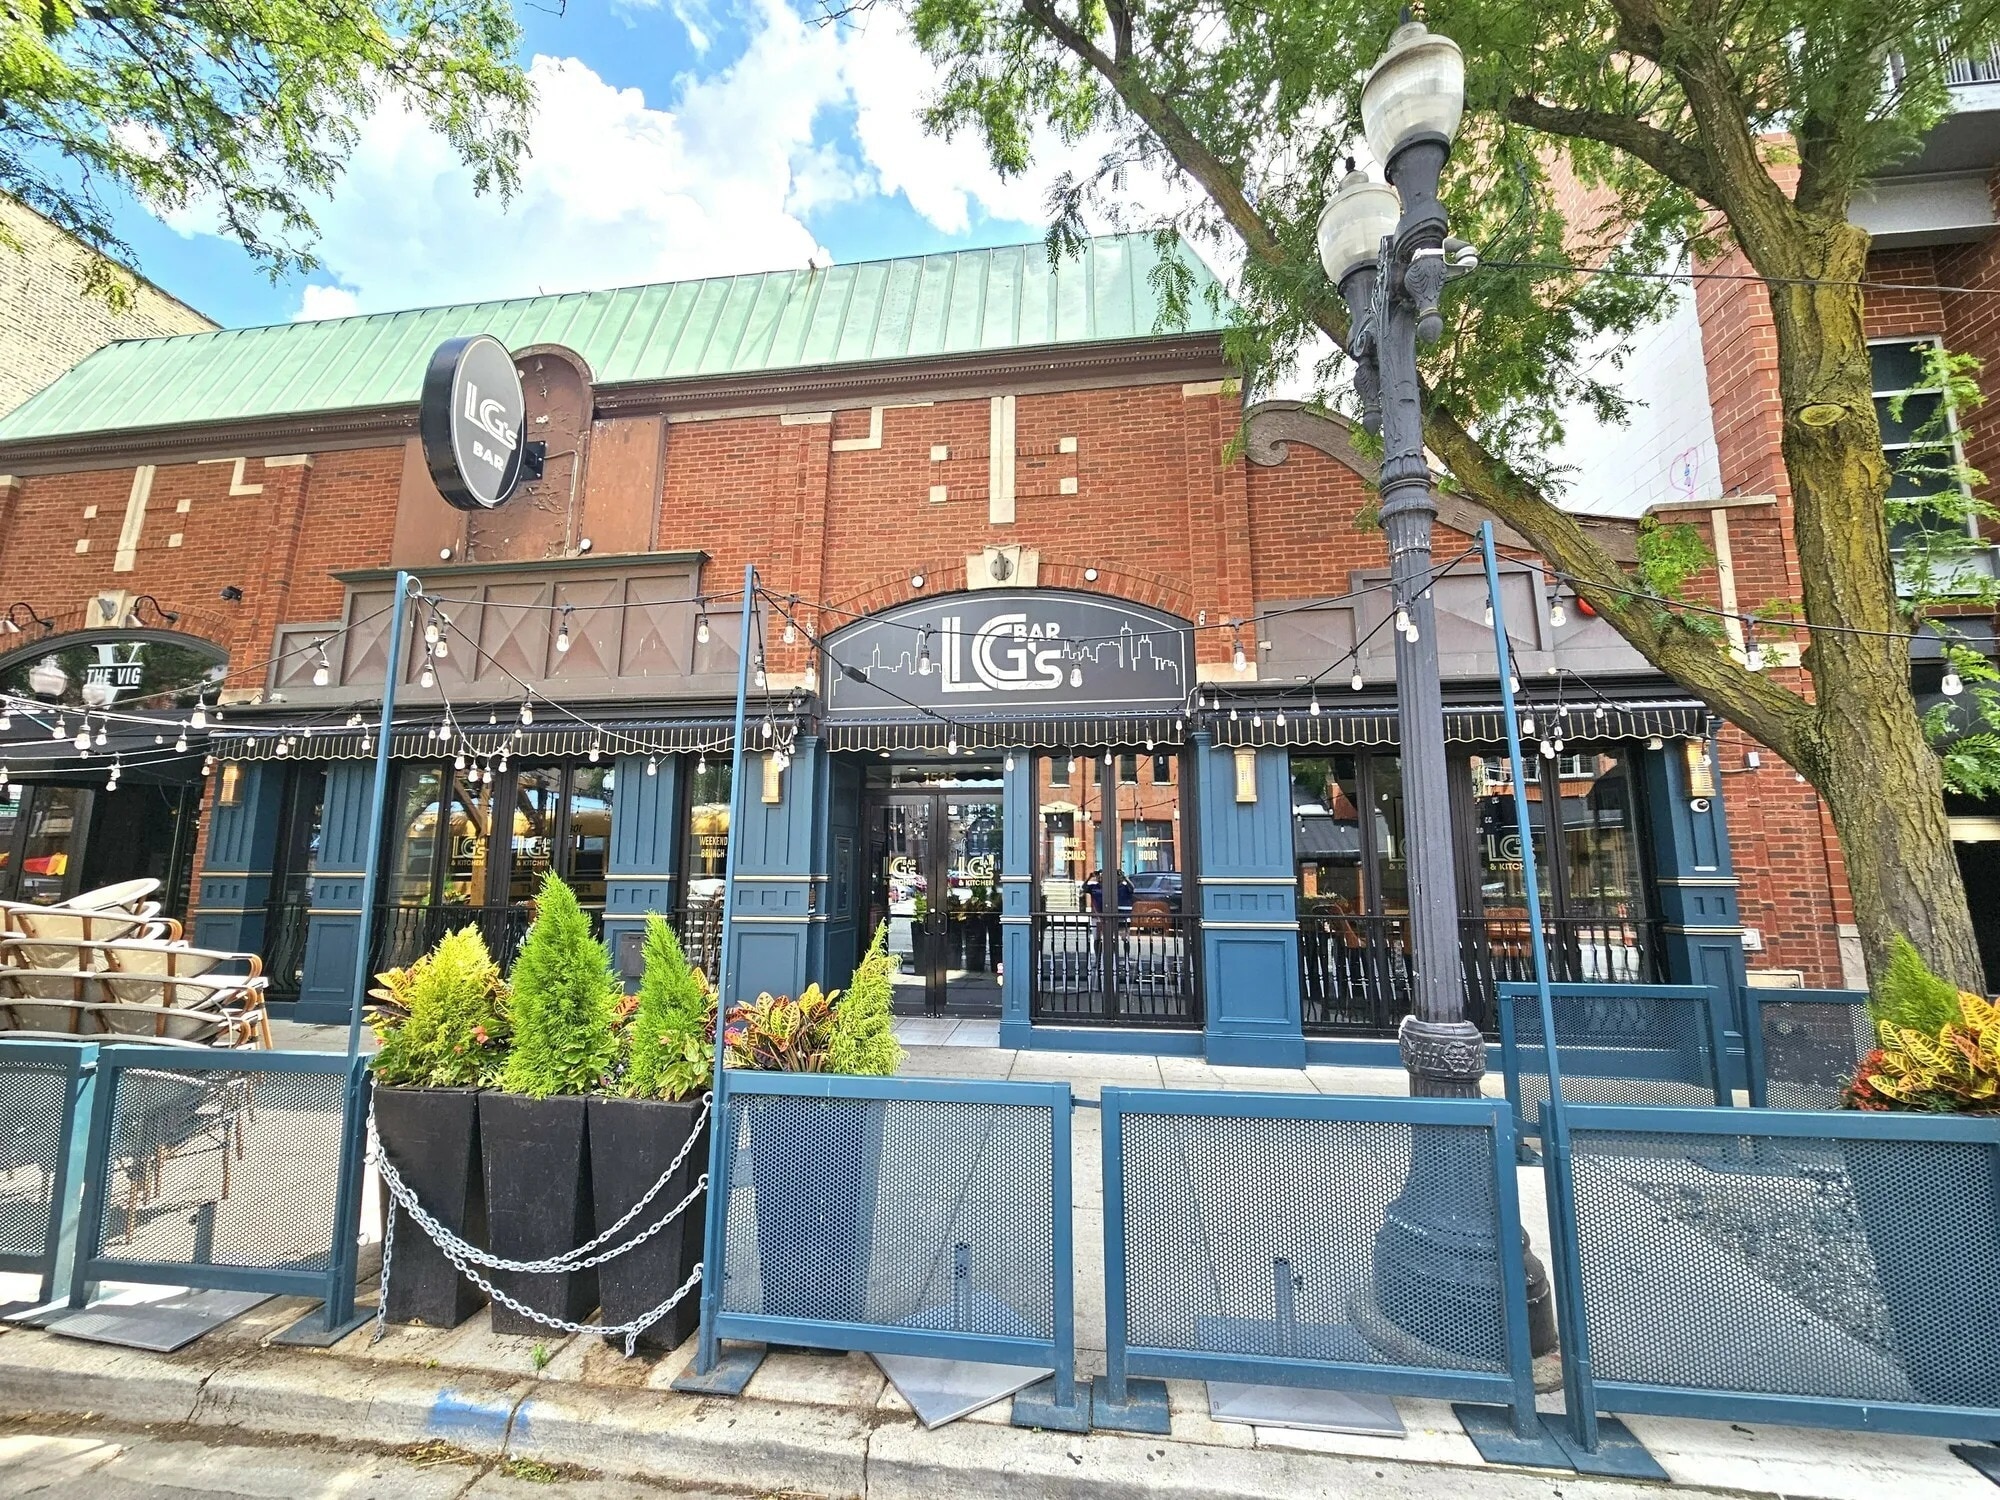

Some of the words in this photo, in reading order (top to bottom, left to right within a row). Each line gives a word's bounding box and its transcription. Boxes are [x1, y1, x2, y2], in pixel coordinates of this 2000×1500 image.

[472, 440, 505, 472] BAR
[1013, 622, 1061, 643] BAR
[87, 668, 113, 685] THE
[117, 667, 141, 685] VIG
[699, 836, 728, 846] WEEKEND
[1137, 837, 1159, 847] HAPPY
[701, 848, 725, 858] BRUNCH
[1138, 850, 1158, 861] HOUR
